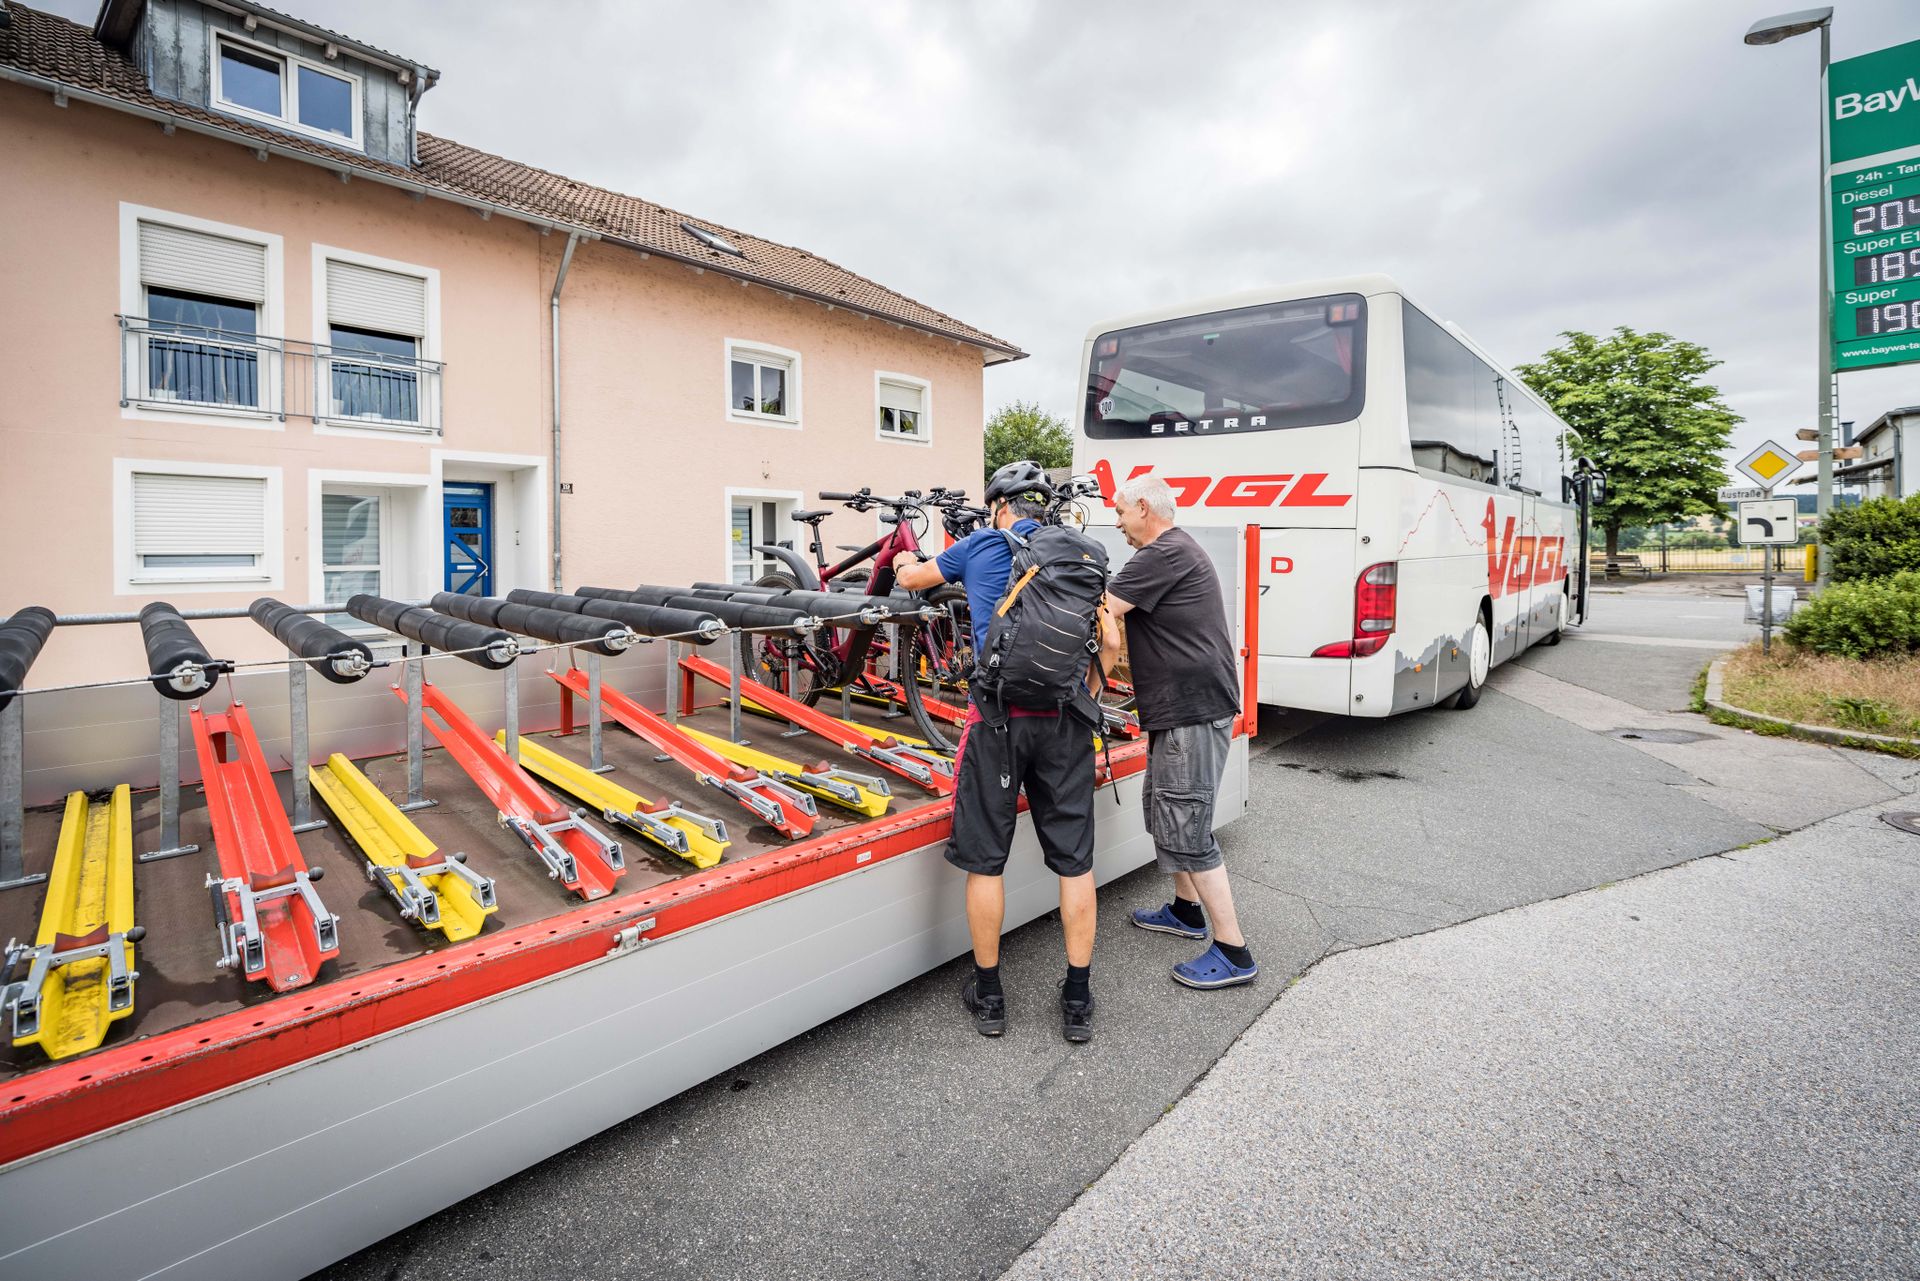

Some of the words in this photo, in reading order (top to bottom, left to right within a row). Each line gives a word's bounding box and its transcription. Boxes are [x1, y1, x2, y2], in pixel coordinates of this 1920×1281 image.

[1856, 171, 1883, 184] 24h
[1842, 184, 1893, 205] Diesel
[1843, 237, 1897, 254] Super
[1845, 288, 1899, 305] Super
[1151, 415, 1267, 434] SETRA
[1720, 489, 1762, 499] Austraße
[1480, 496, 1568, 600] VOGL
[1270, 556, 1294, 574] D
